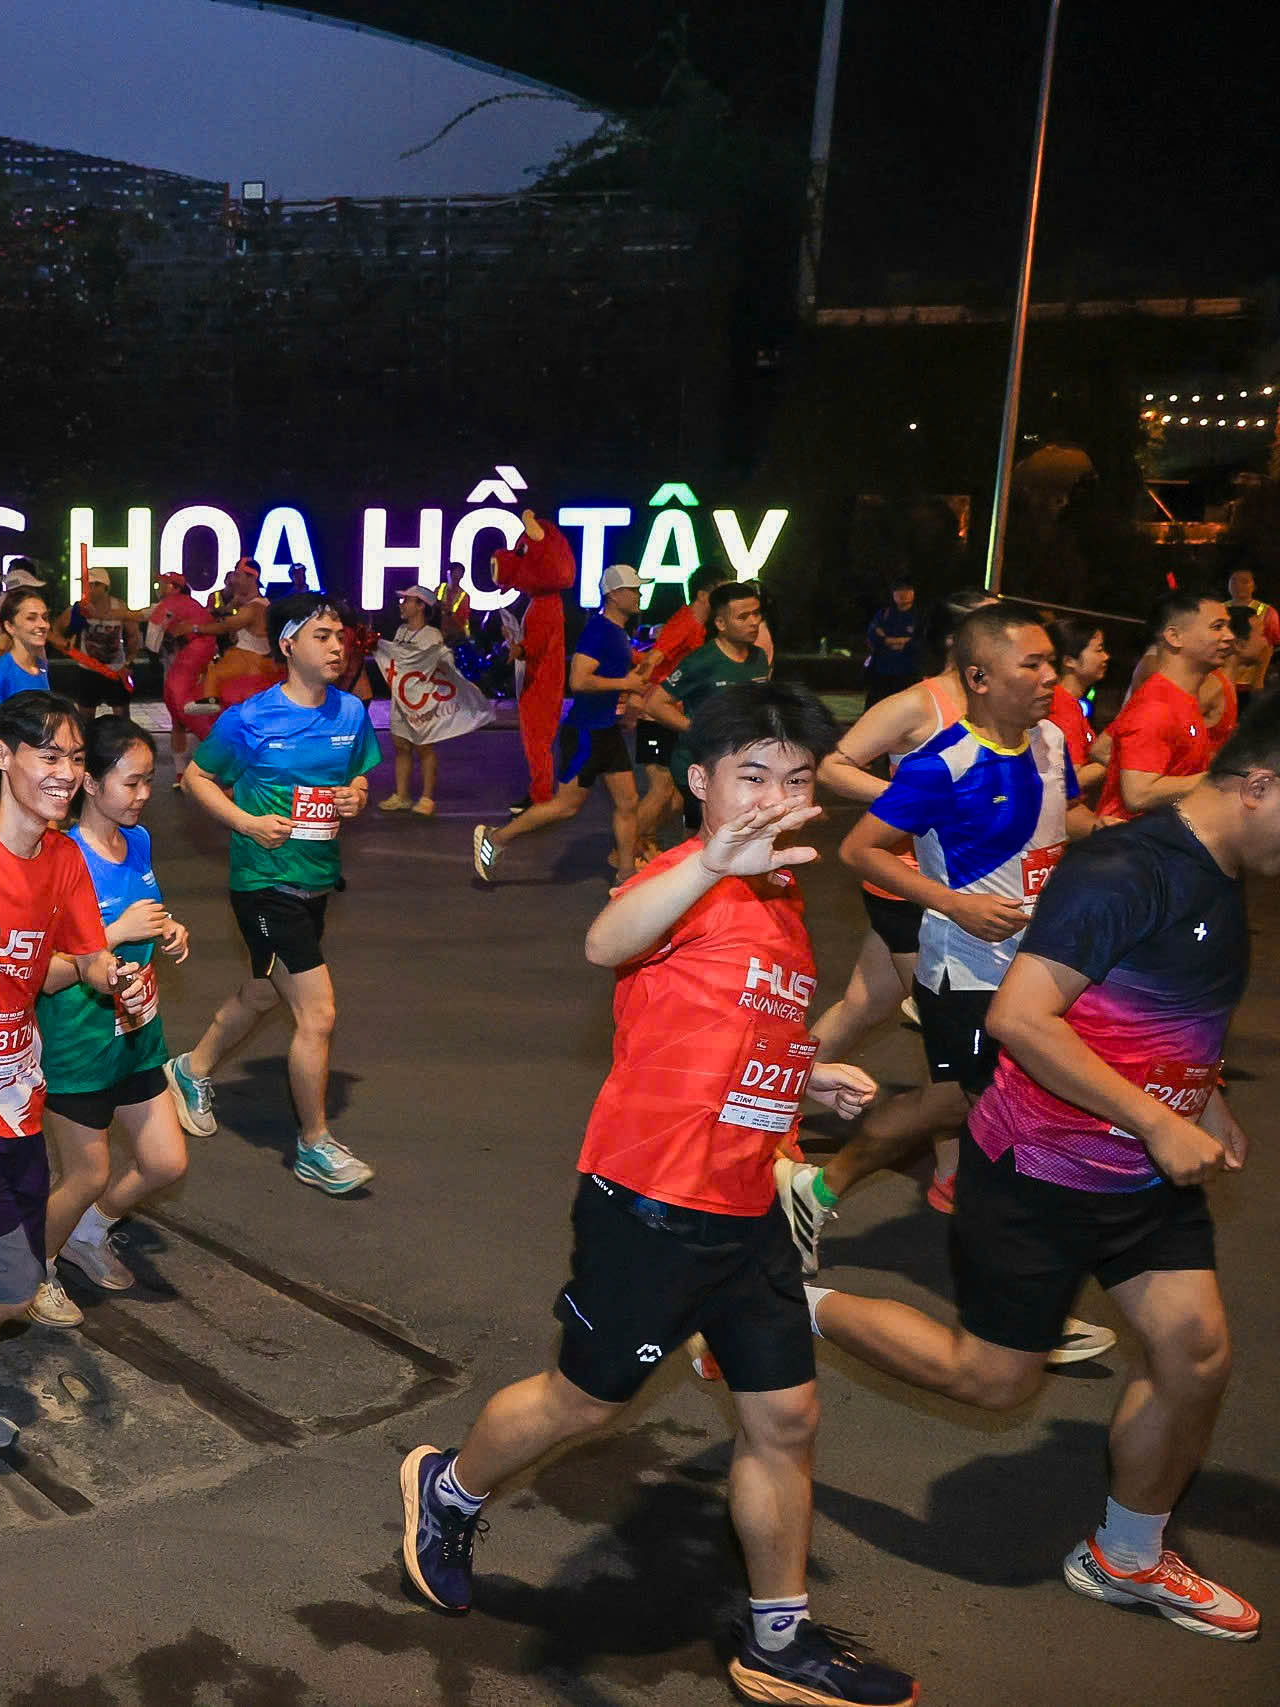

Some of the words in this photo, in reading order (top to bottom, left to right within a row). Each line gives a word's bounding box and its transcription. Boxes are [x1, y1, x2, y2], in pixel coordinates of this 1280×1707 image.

[70, 506, 320, 610] HOA
[362, 466, 528, 611] HỒ
[559, 483, 788, 610] TÂY
[745, 956, 817, 1007] HUS
[741, 1059, 808, 1095] D211
